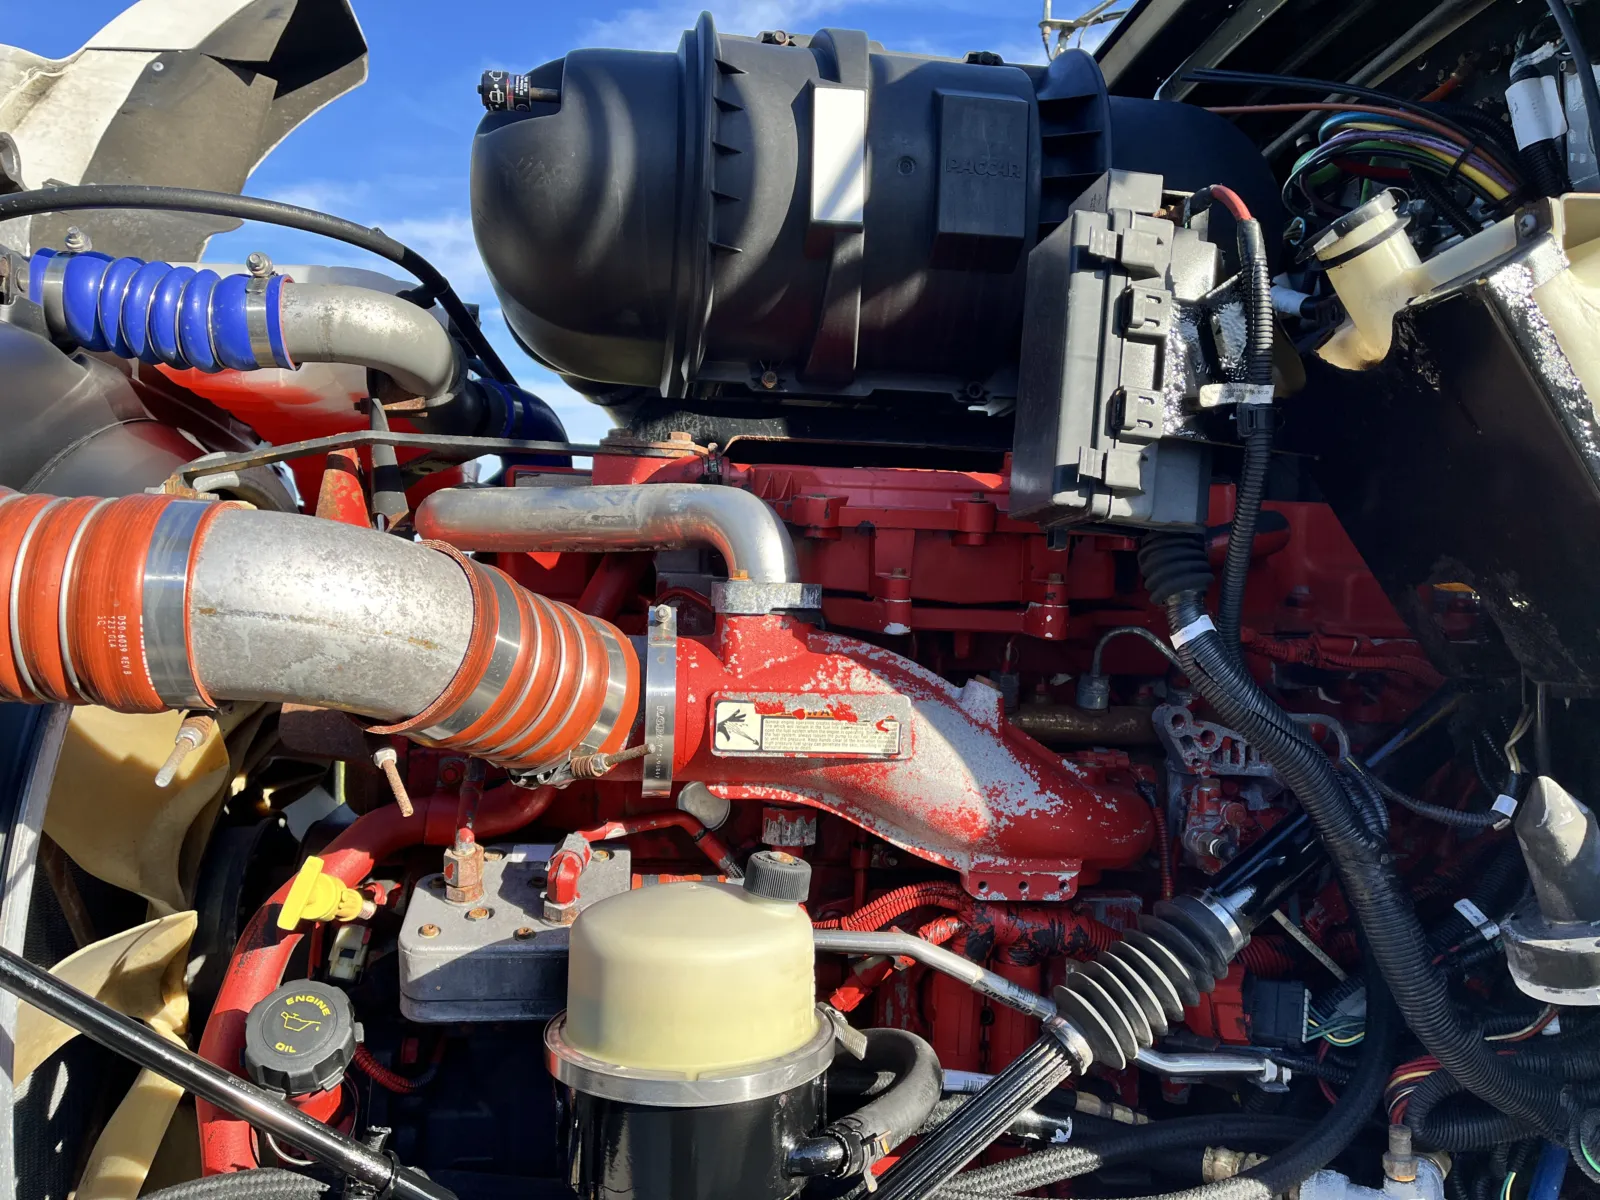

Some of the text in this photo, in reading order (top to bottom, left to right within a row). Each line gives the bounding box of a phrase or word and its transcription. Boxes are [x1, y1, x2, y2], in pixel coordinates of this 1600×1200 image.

[945, 156, 1021, 179] PACCAR
[285, 994, 331, 1017] ENGINE
[274, 1041, 297, 1054] OIL
